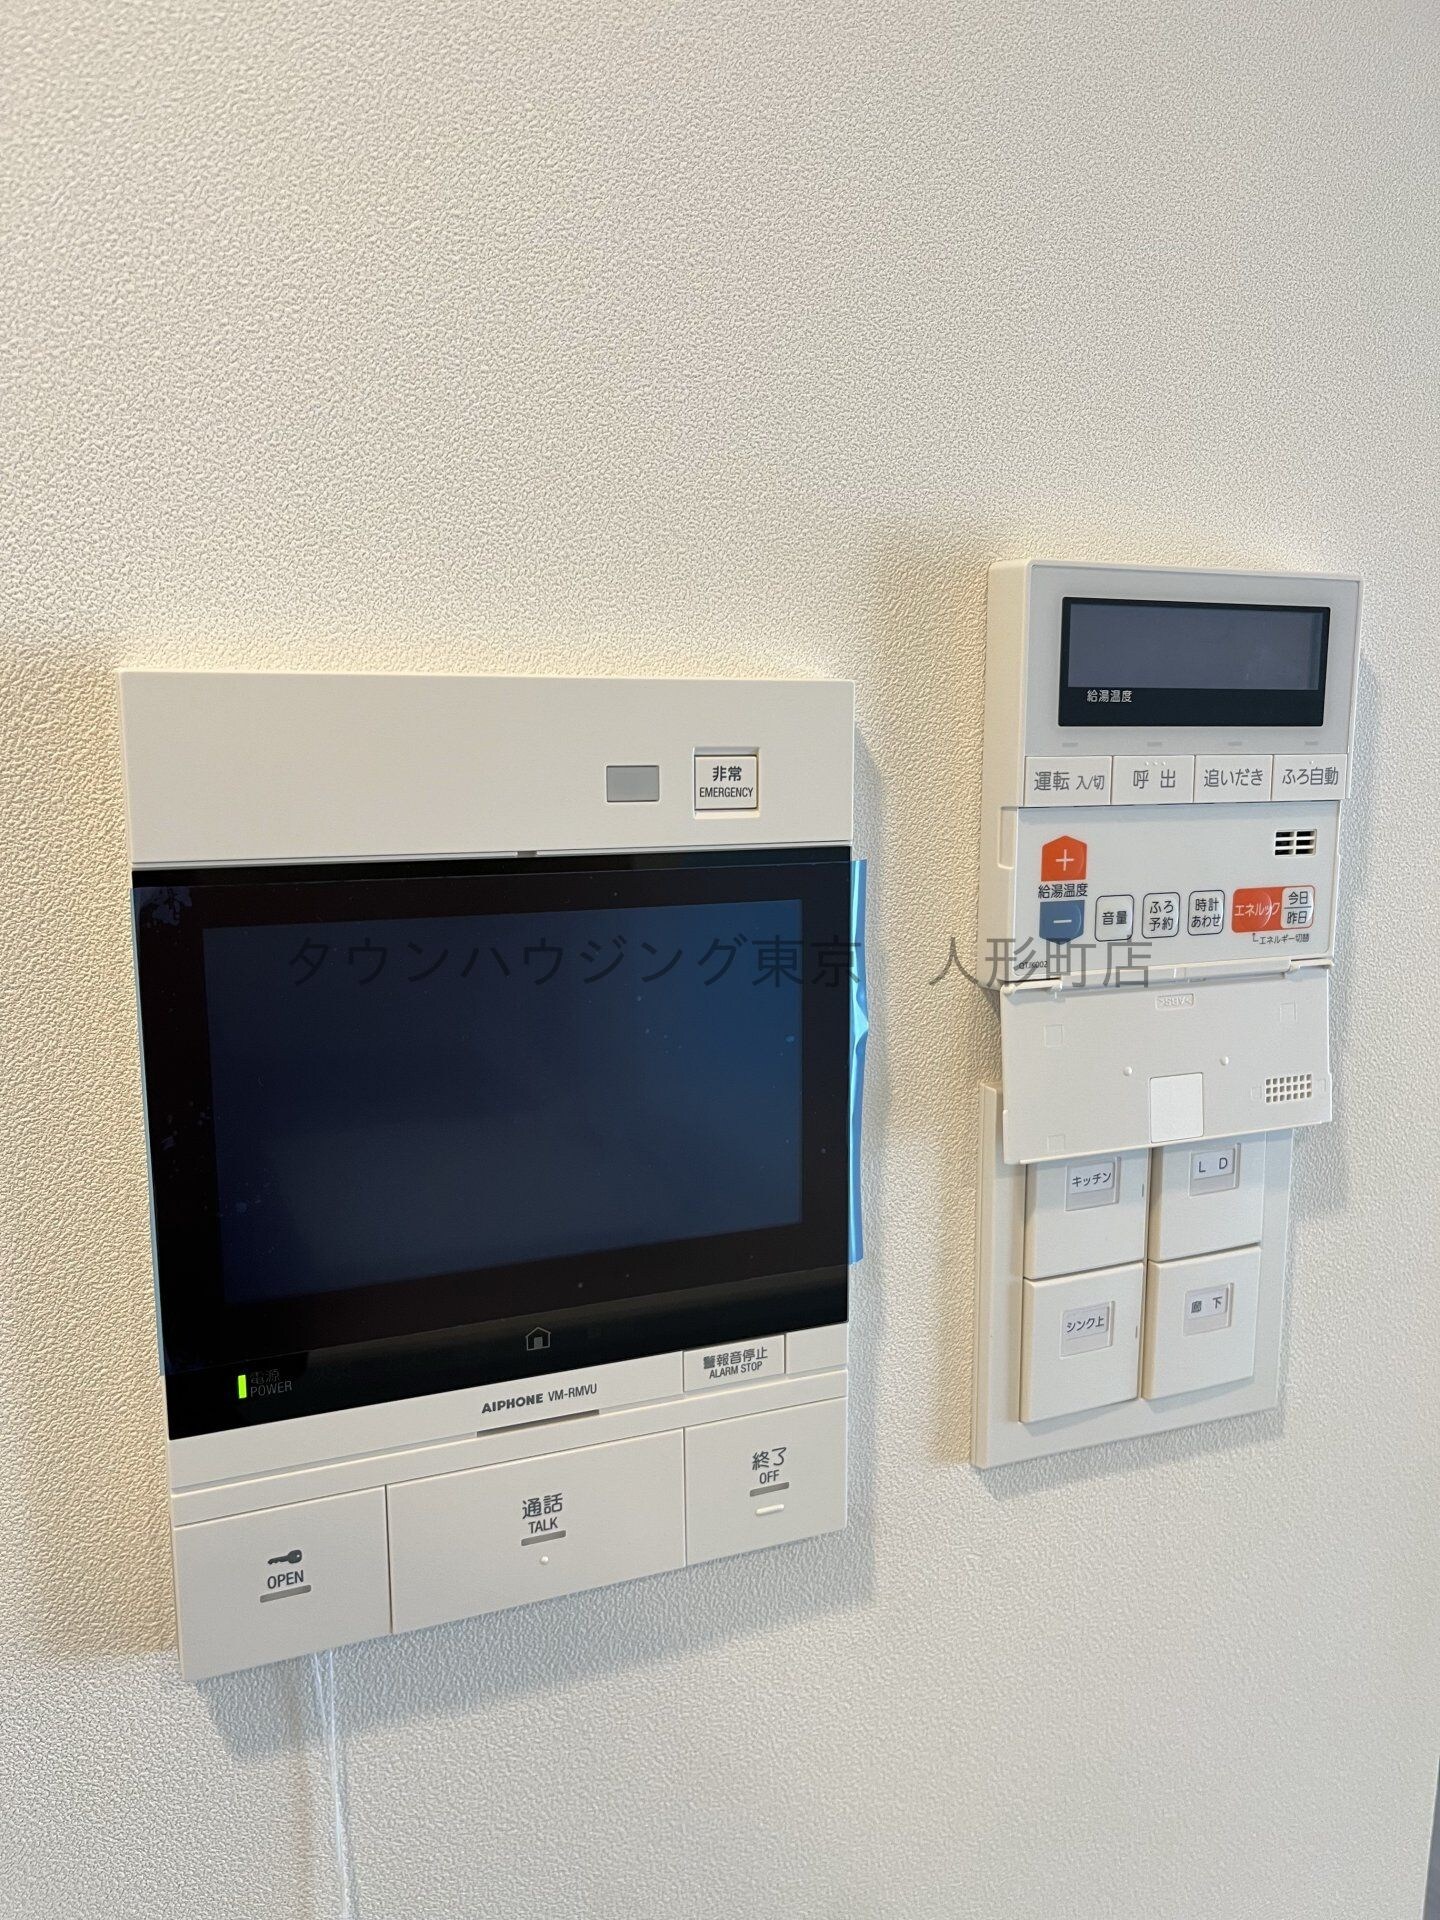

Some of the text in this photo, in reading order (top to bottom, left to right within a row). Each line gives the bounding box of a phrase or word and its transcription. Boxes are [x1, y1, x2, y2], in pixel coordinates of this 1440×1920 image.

[1086, 689, 1132, 703] 給湯温度
[712, 765, 742, 782] 非常
[1034, 771, 1105, 791] 運転 入/切
[1204, 768, 1264, 788] 追いだき
[1281, 766, 1339, 787] ふろ自動
[699, 787, 753, 798] EMERGENCY
[1038, 883, 1089, 899] 給湯温度
[1288, 891, 1309, 905] 今日
[1149, 901, 1174, 914] ふろ
[1195, 899, 1218, 912] 時計
[1102, 911, 1128, 926] 音量
[1149, 917, 1174, 931] 予約
[1191, 914, 1222, 928] あわせ
[1286, 911, 1307, 924] 昨日
[1071, 1172, 1113, 1187] キッチン
[1066, 1315, 1106, 1334] シンク上
[709, 1360, 763, 1379] ALARM STOP
[250, 1381, 293, 1397] POWER
[481, 1383, 598, 1414] AIPHONE VM-RMVU
[752, 1446, 787, 1471] 終了
[758, 1469, 780, 1485] OFF
[522, 1493, 563, 1520] 通話
[528, 1517, 559, 1535] TALK
[267, 1569, 305, 1590] OPEN
